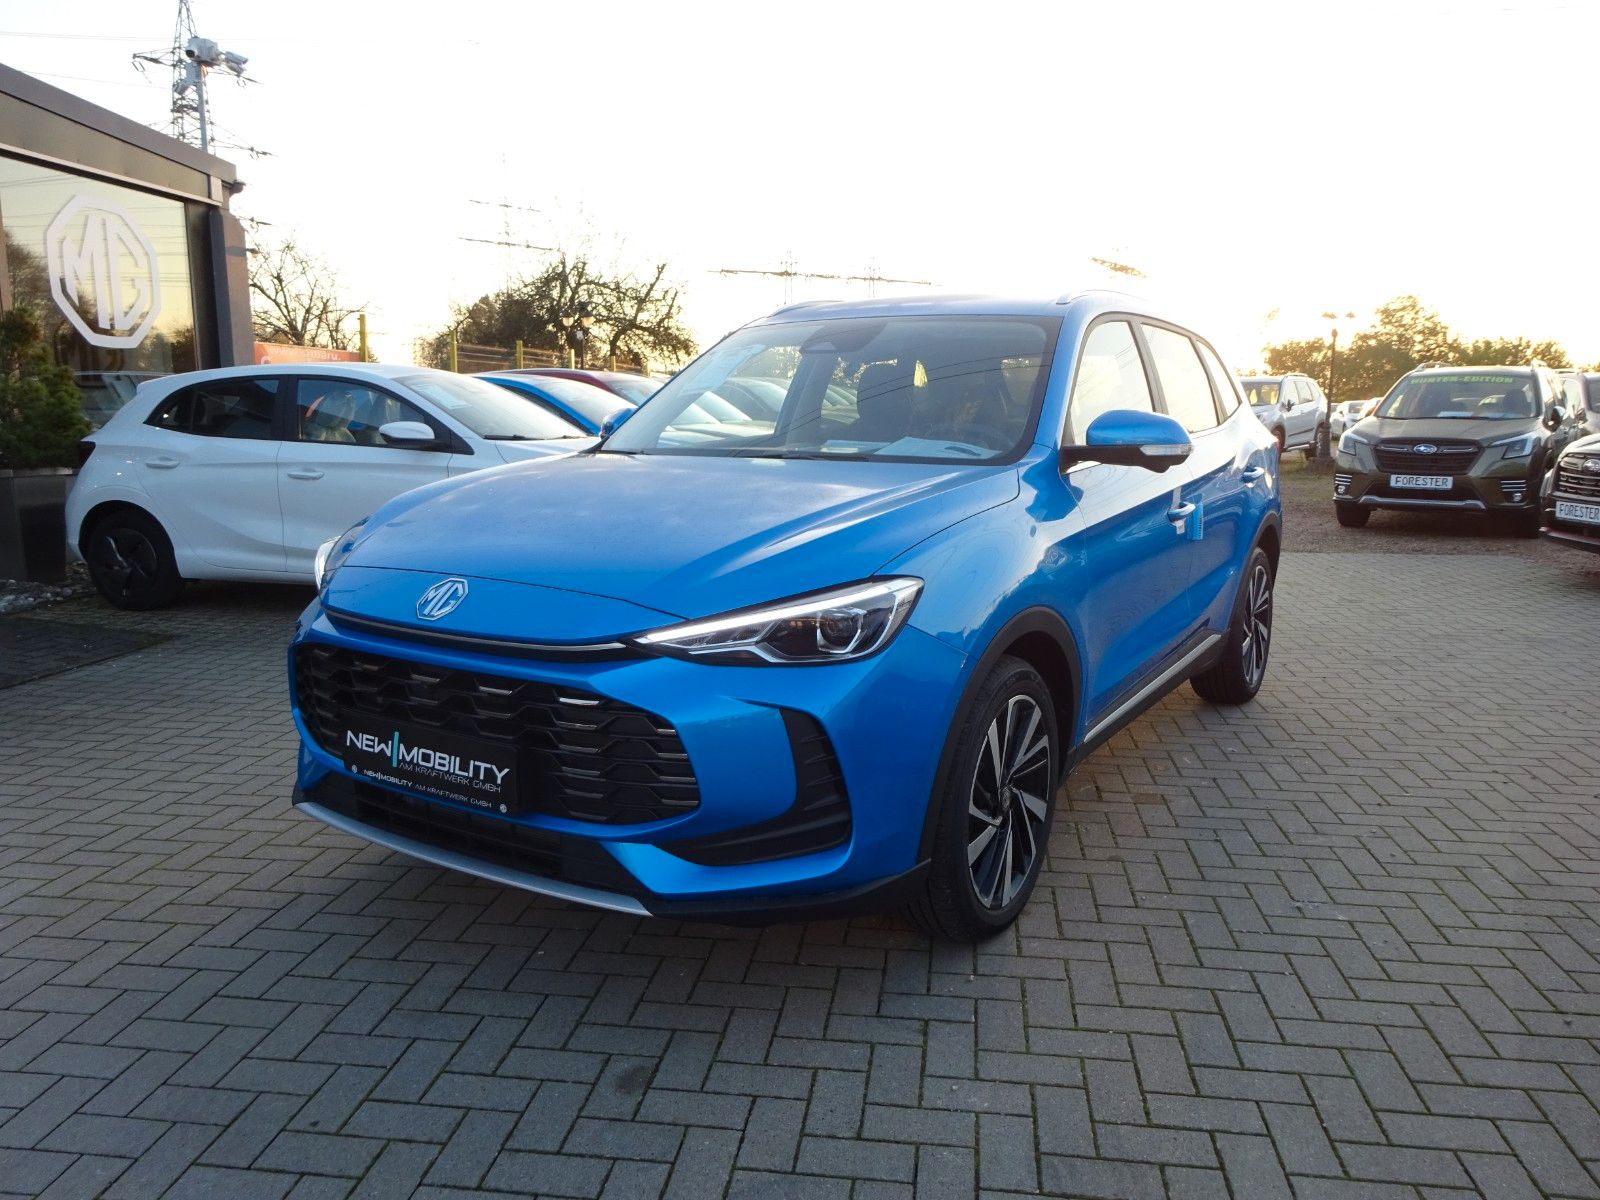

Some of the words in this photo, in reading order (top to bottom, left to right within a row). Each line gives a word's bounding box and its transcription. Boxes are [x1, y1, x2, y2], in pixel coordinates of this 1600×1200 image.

[61, 213, 148, 332] MG
[1395, 476, 1448, 487] FORESTER
[1559, 503, 1600, 520] FORESTER
[420, 582, 464, 616] MG
[399, 743, 510, 785] MOBILITY
[399, 762, 414, 773] AM
[415, 766, 470, 787] KRAFTWERK
[472, 780, 501, 793] GMBH
